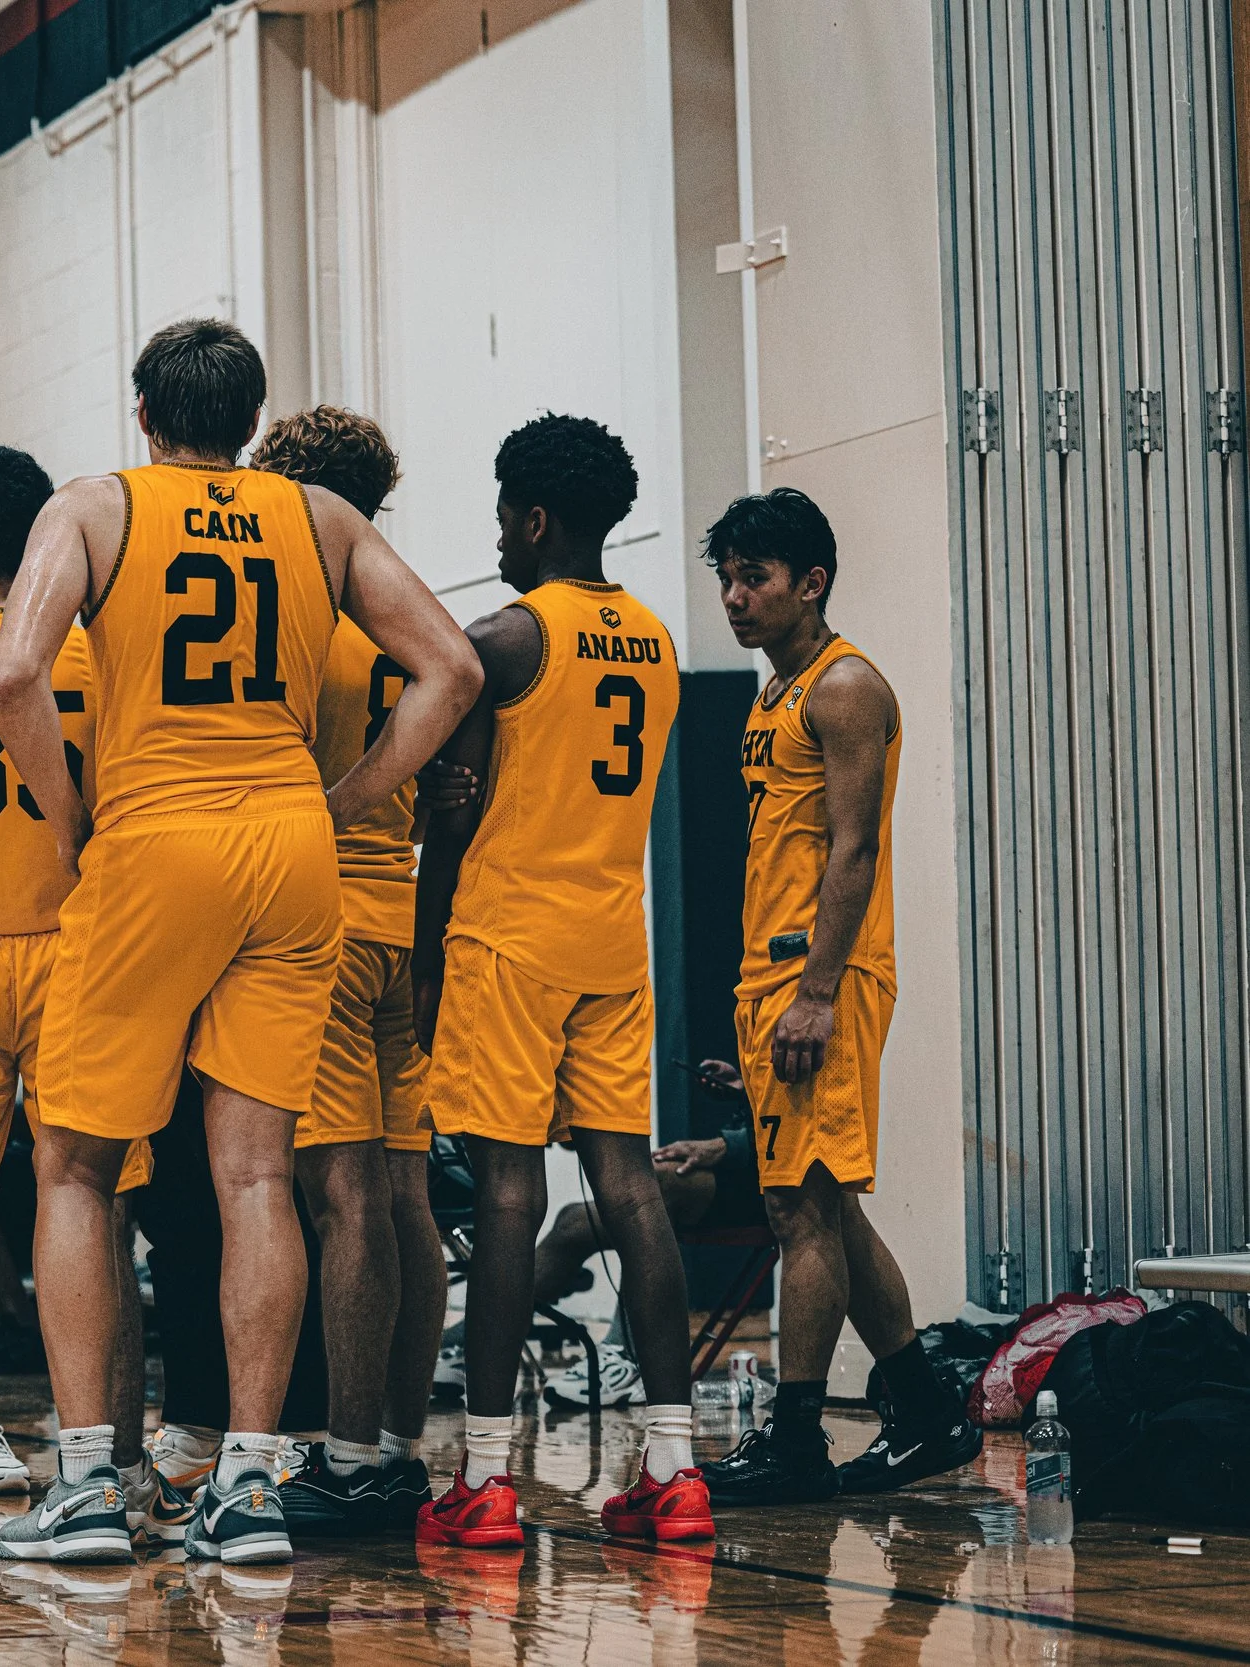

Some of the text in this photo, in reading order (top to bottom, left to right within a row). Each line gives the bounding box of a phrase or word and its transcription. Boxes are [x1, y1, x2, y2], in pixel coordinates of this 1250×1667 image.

[184, 508, 264, 543] CAIN
[162, 551, 287, 706] 21
[577, 631, 661, 664] ANADU
[591, 674, 646, 797] 3
[742, 729, 777, 767] HIM
[759, 1115, 782, 1161] 7
